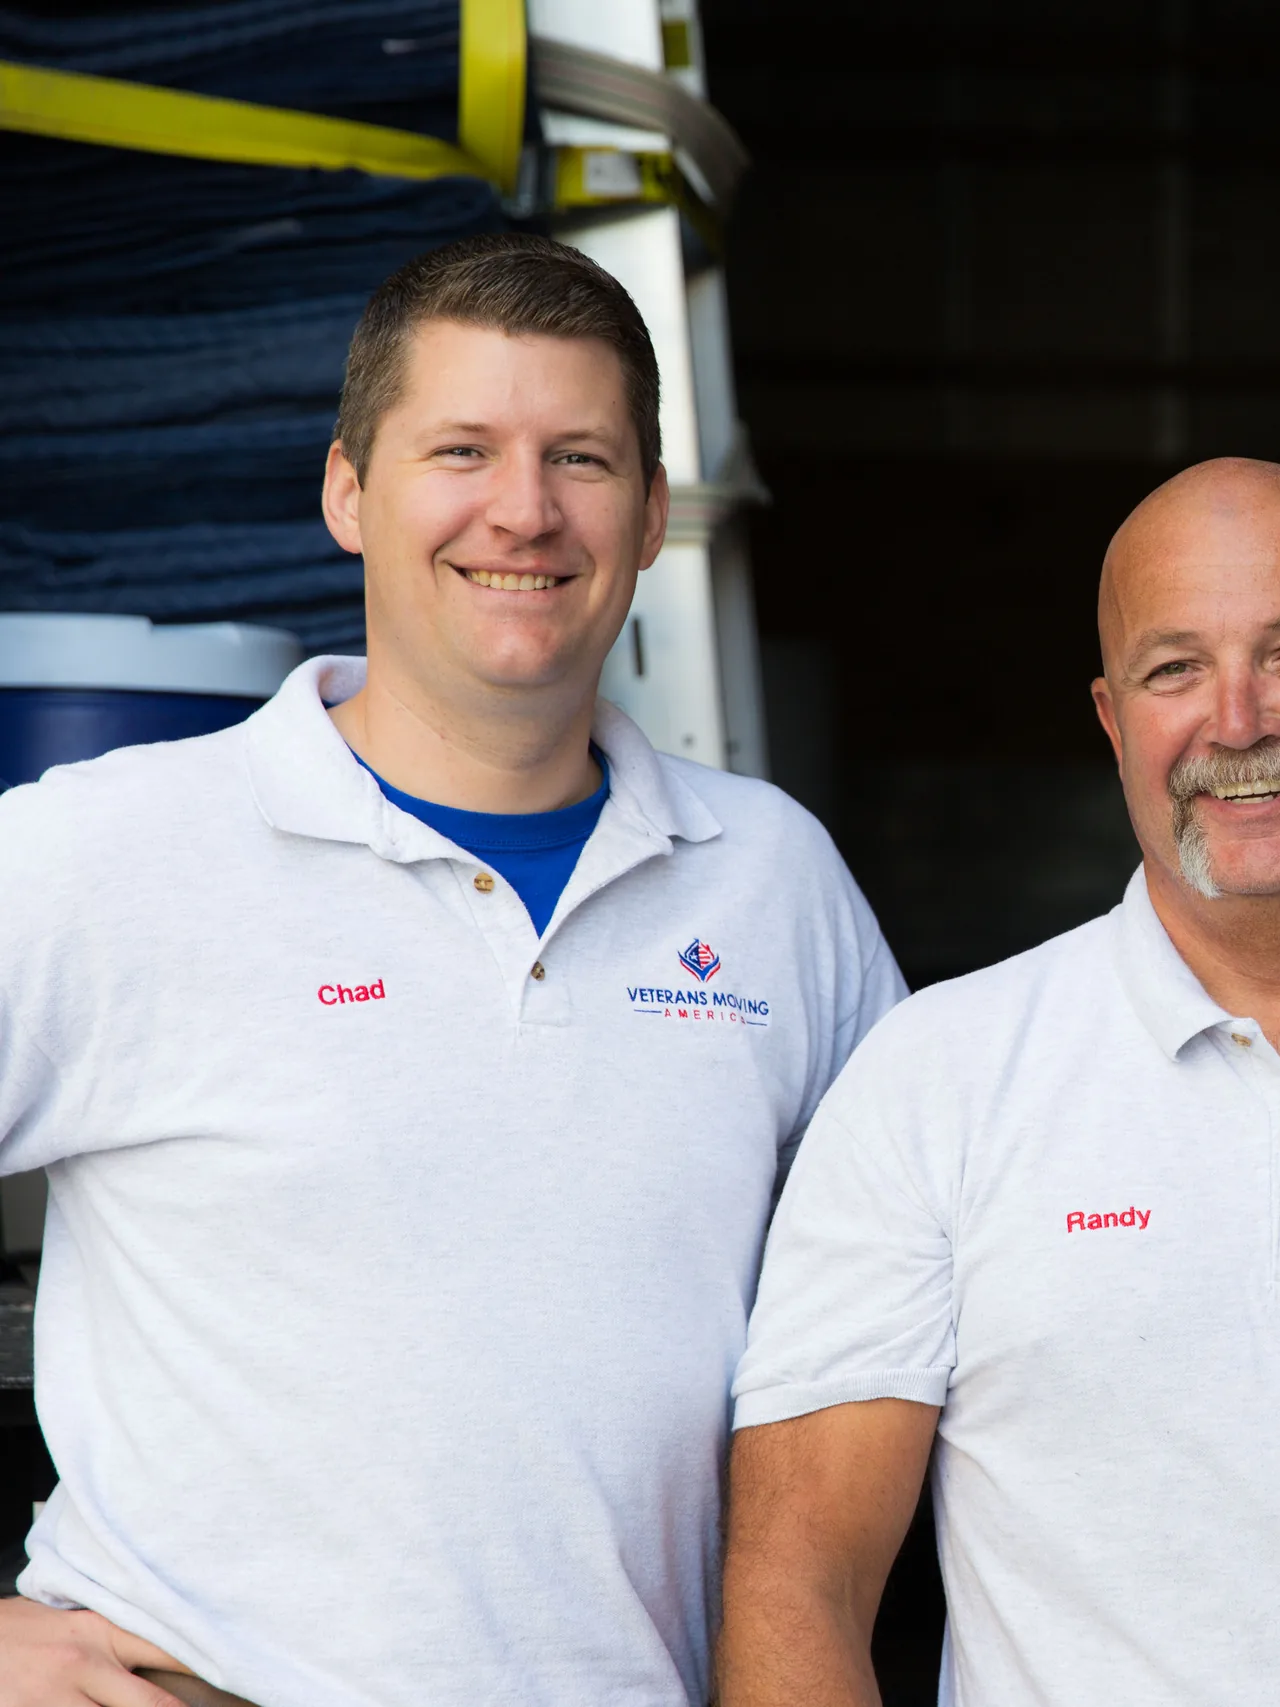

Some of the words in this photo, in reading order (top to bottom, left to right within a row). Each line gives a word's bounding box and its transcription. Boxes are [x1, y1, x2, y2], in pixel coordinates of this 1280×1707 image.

[317, 977, 386, 1006] Chad
[626, 986, 708, 1006] VETERANS
[712, 991, 770, 1016] MOVING
[664, 1008, 746, 1025] AMERICA
[1066, 1205, 1152, 1234] Randy
